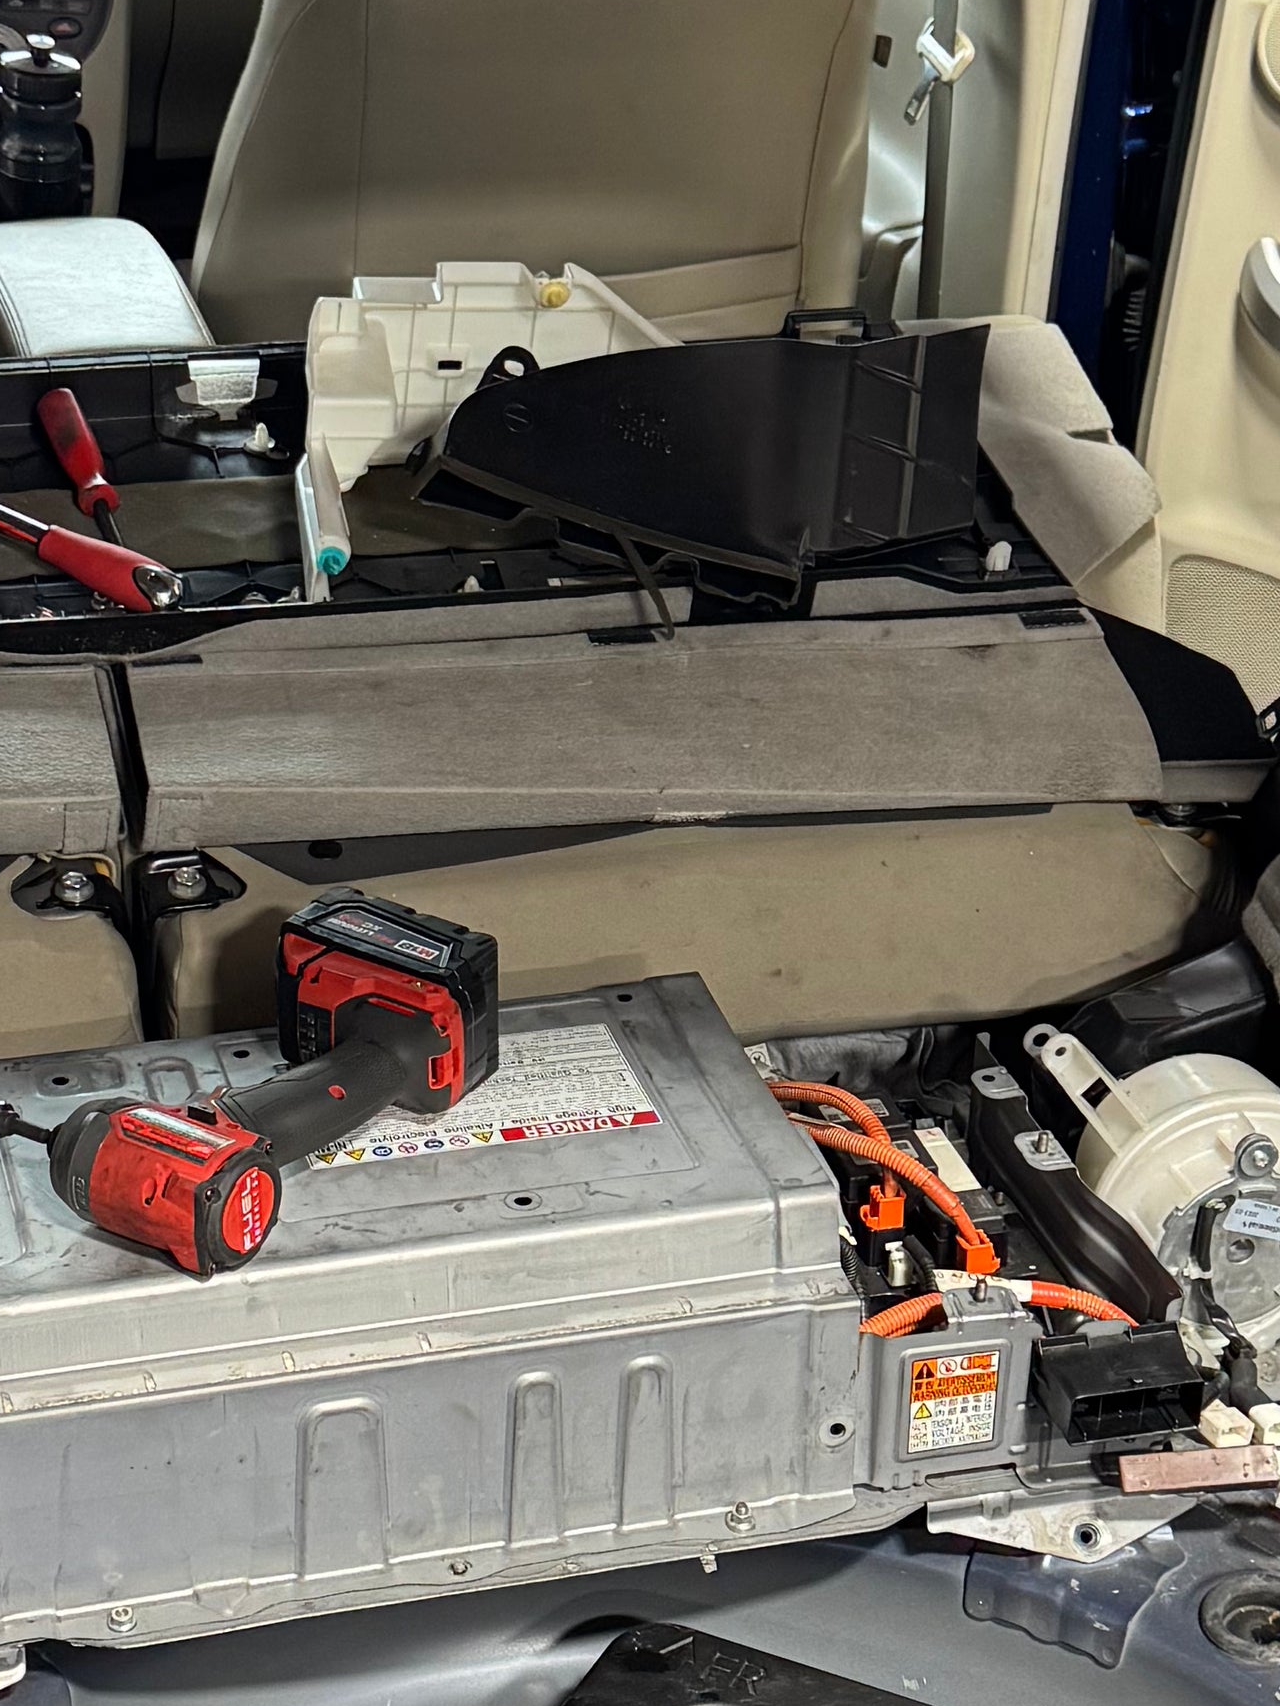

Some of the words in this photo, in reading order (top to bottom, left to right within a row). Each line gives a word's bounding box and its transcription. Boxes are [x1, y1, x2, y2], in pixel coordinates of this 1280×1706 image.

[523, 1114, 614, 1139] DANGER
[555, 1107, 601, 1122] Voltage
[240, 1175, 255, 1251] FUEL
[700, 1650, 766, 1697] FR
